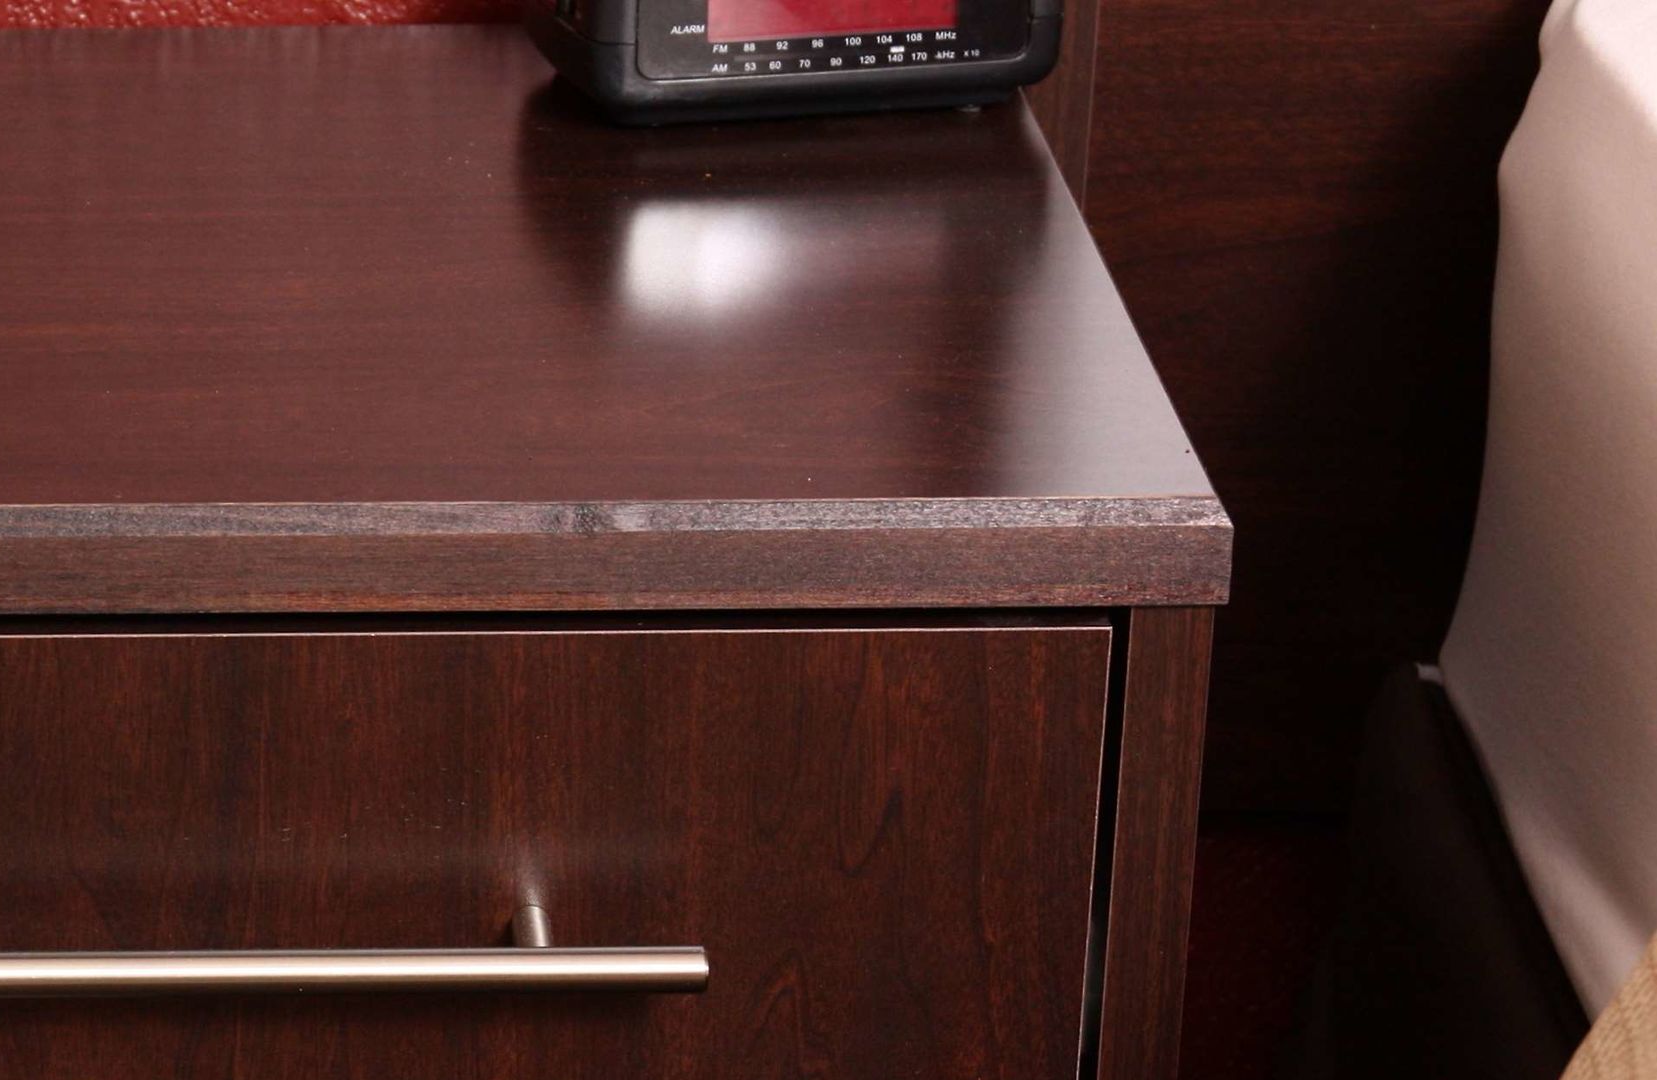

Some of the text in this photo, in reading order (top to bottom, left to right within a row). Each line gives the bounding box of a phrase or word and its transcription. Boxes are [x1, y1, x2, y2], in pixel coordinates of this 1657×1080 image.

[670, 24, 705, 35] ALARM
[712, 31, 957, 53] FM 88 92 96 100 104 108 MHz
[711, 63, 728, 72] AM
[744, 62, 757, 71] 53
[769, 60, 782, 70] 60
[799, 59, 811, 68] 70
[830, 57, 843, 67] 90
[859, 55, 876, 65] 120
[887, 54, 904, 63] 140
[911, 52, 928, 61] 170
